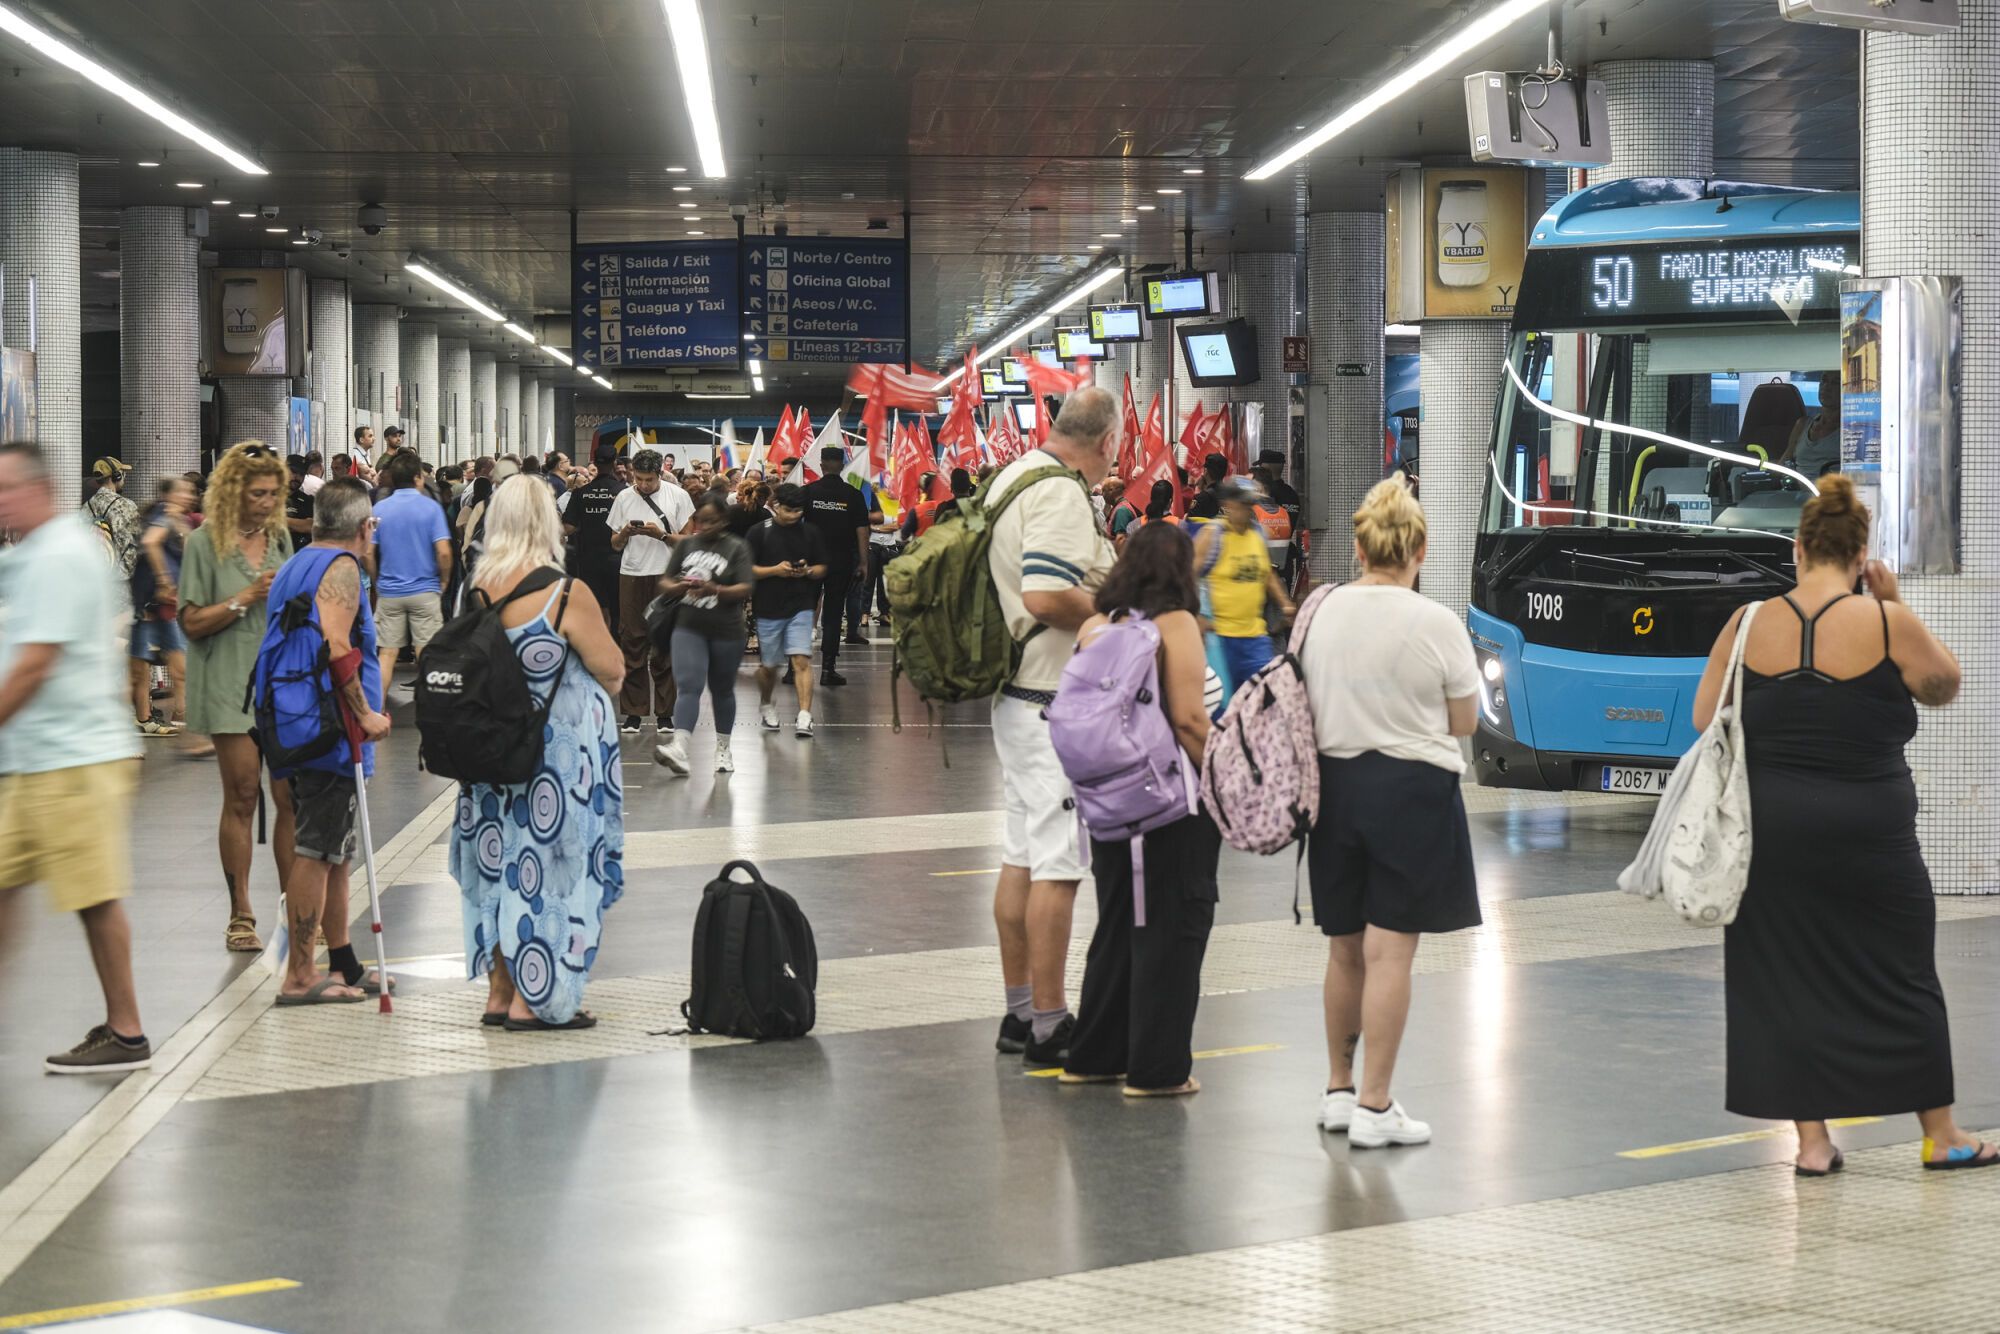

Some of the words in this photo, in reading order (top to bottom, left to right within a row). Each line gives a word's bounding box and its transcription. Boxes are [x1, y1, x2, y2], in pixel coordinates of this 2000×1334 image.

[1478, 139, 1486, 147] 10
[1456, 222, 1472, 246] Y
[793, 252, 832, 264] Norte
[844, 252, 892, 265] Centro
[1445, 247, 1484, 256] YBARRA
[625, 256, 668, 269] Salida
[684, 255, 710, 267] Exit
[1661, 254, 1701, 279] FARO
[1708, 252, 1729, 277] DE
[1734, 247, 1845, 277] MASPALOMAS
[626, 273, 710, 287] Información
[792, 274, 842, 287] Oficina
[846, 276, 890, 288] Global
[1594, 257, 1633, 307] 50
[626, 287, 653, 296] Venta
[656, 286, 668, 295] de
[672, 286, 710, 296] tarjetas
[1152, 286, 1158, 298] 9
[1498, 286, 1513, 304] Y
[1692, 276, 1814, 304] SUPERFARO
[626, 302, 680, 315] Guagua
[686, 304, 693, 314] y
[698, 299, 725, 311] Taxi
[792, 298, 835, 310] Aseos
[846, 299, 877, 310] W.C.
[793, 318, 858, 332] Cafetería
[1096, 316, 1100, 326] 8
[626, 324, 686, 337] Teléfono
[626, 346, 682, 360] Tiendas
[694, 345, 737, 358] Shops
[794, 340, 840, 352] Líneas
[844, 342, 904, 354] 12-13-17
[794, 352, 840, 362] Dirección
[1404, 418, 1417, 429] 1703
[1527, 592, 1563, 621] 1908
[1605, 706, 1665, 723] SCANIA
[1614, 770, 1652, 789] 2067
